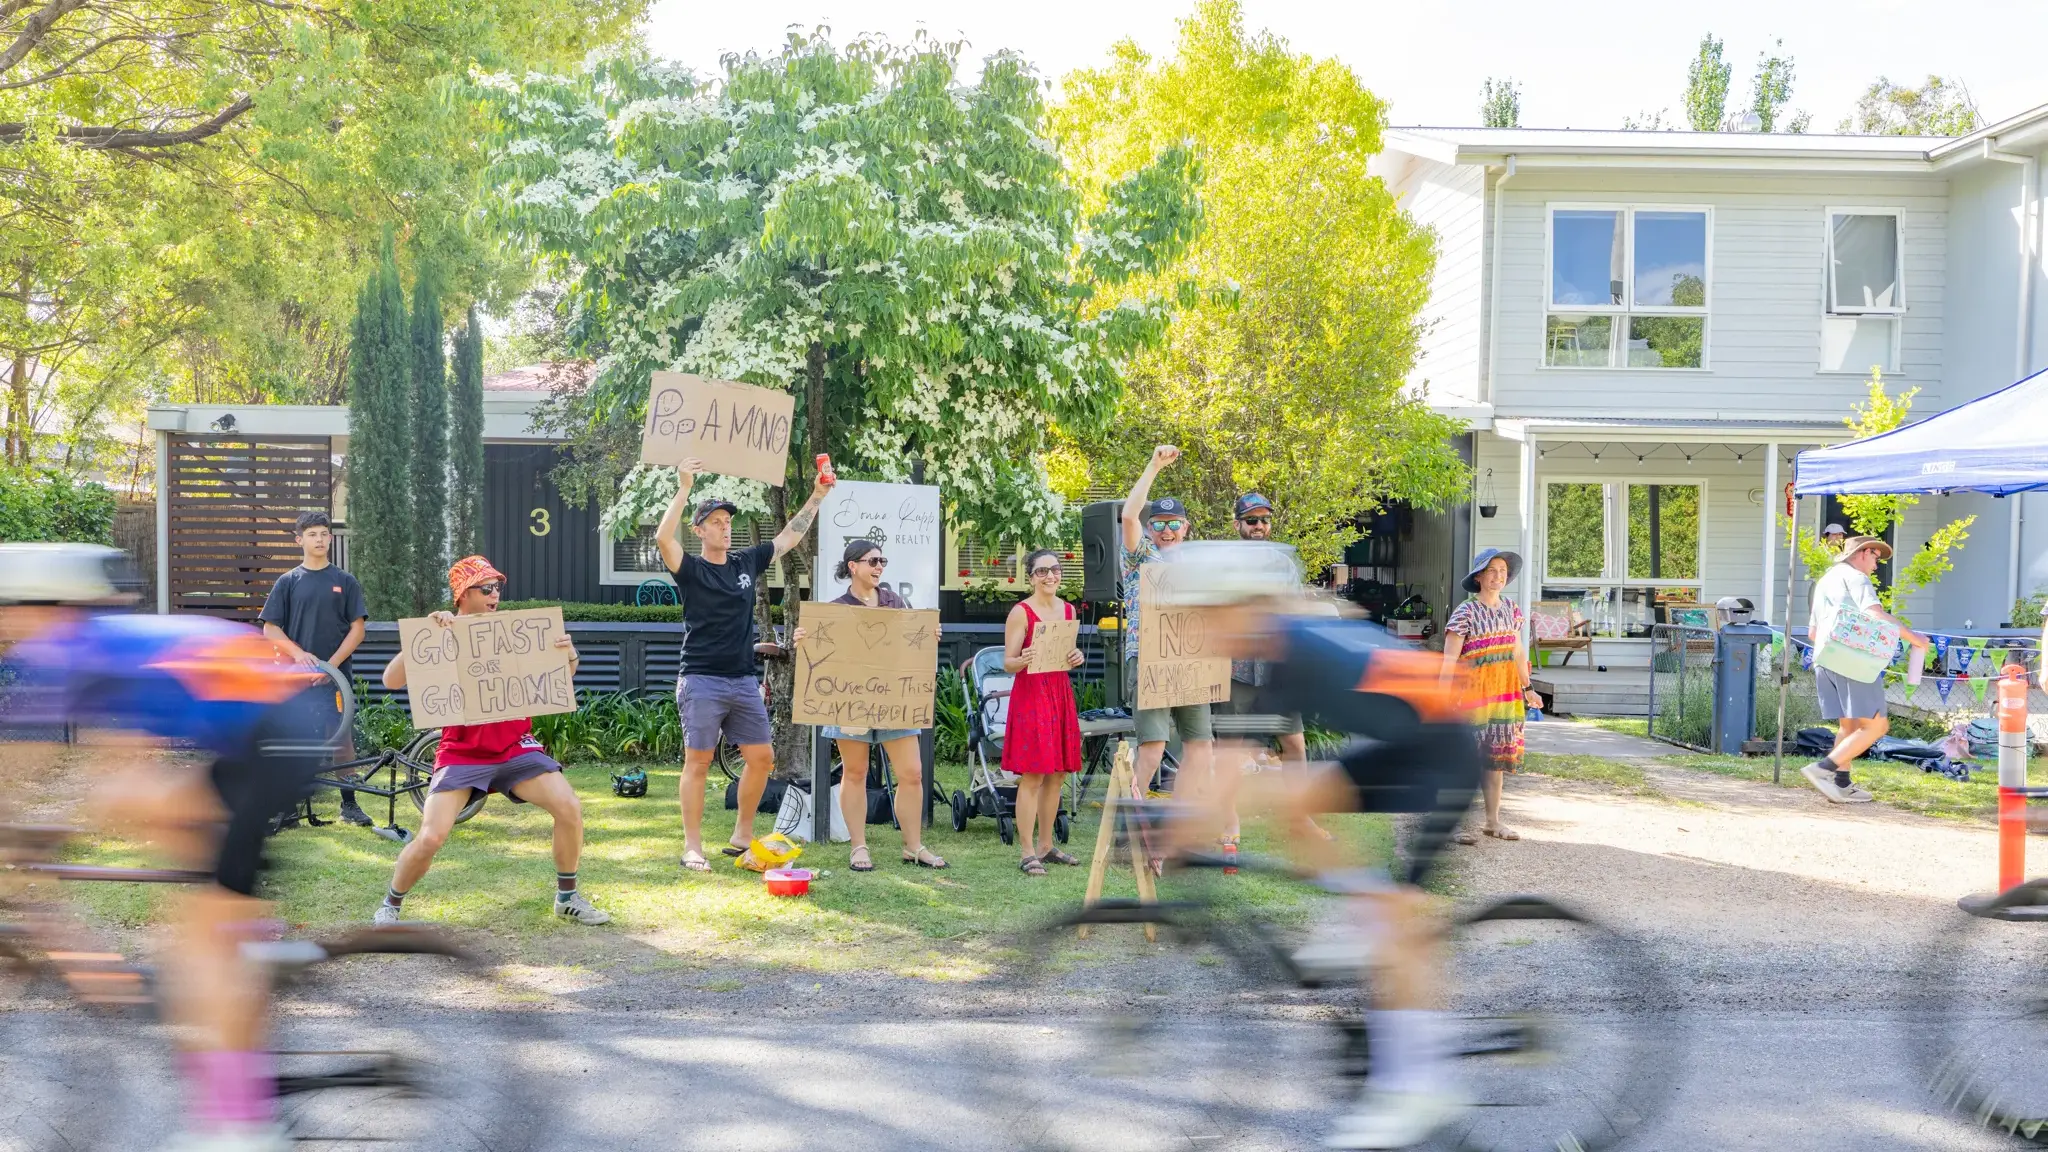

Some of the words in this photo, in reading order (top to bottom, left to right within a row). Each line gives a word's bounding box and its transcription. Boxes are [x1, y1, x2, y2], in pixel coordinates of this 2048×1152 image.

[700, 399, 722, 442] A
[729, 402, 789, 454] MONO
[529, 507, 551, 537] 3
[895, 534, 931, 545] REALTY
[411, 628, 459, 665] GO
[468, 617, 551, 658] FAST
[467, 659, 502, 677] OR
[1731, 650, 1748, 671] 5
[421, 683, 466, 716] GO
[478, 665, 568, 714] HOME
[803, 699, 846, 724] SLAY
